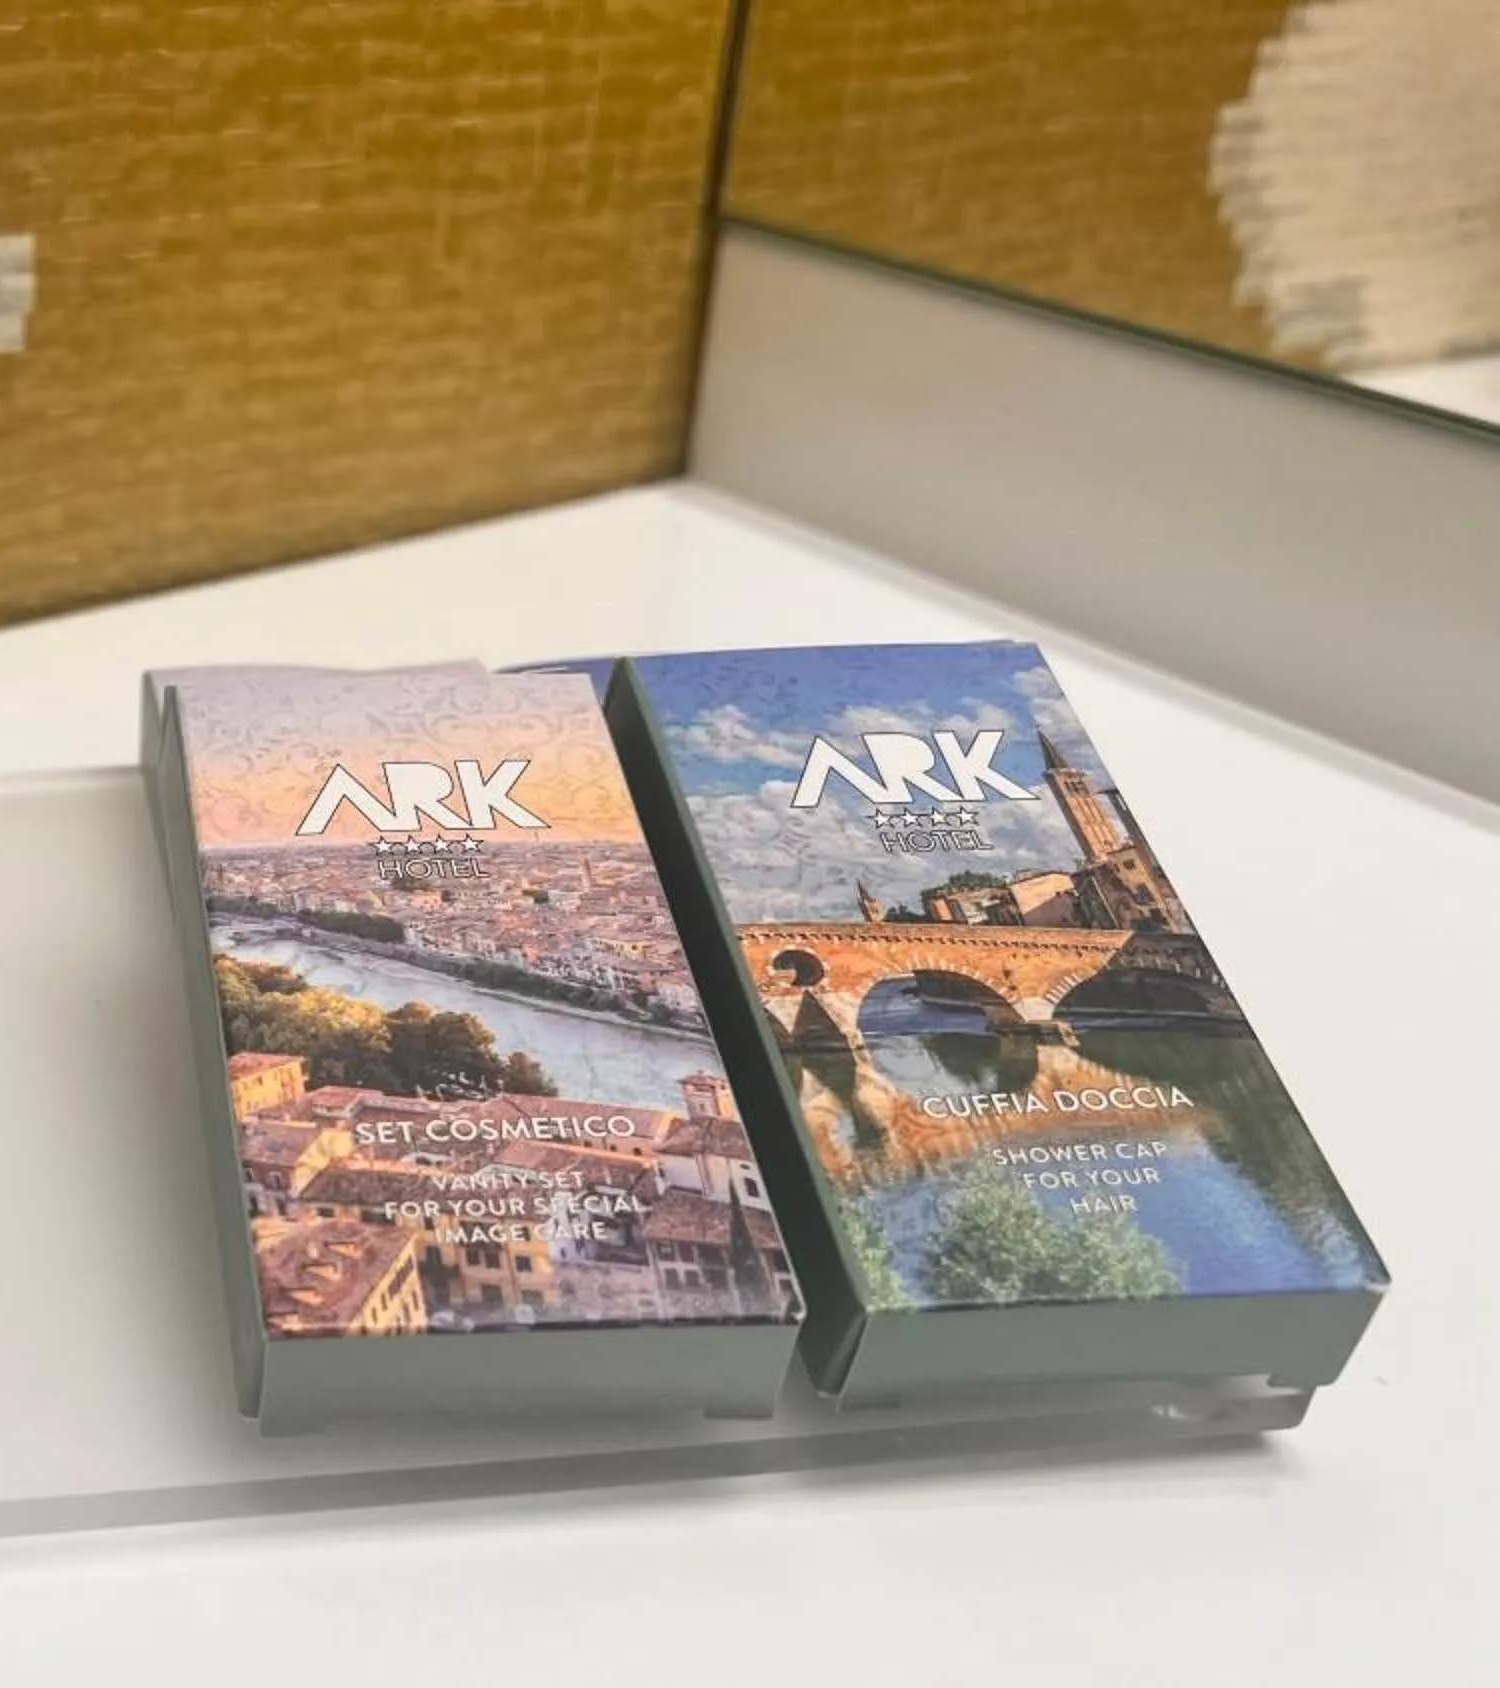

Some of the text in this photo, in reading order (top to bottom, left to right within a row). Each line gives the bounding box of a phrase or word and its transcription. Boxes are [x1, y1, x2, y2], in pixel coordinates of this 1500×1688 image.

[790, 729, 1041, 808] ARK
[294, 759, 552, 836] ARK
[879, 828, 995, 853] HOTEL
[377, 856, 490, 881] HOTEL
[922, 1085, 1194, 1120] CUFFIA DOCCIA
[355, 1115, 636, 1144] SET COSMETICO
[993, 1141, 1168, 1165] SHOWER CAP
[431, 1171, 584, 1192] VANITY SET
[1023, 1167, 1161, 1189] FOR YOUR
[384, 1194, 650, 1221] FOR YOUR SPECIAL
[1069, 1194, 1139, 1215] HAIR
[435, 1221, 609, 1244] IMAGE CARE
